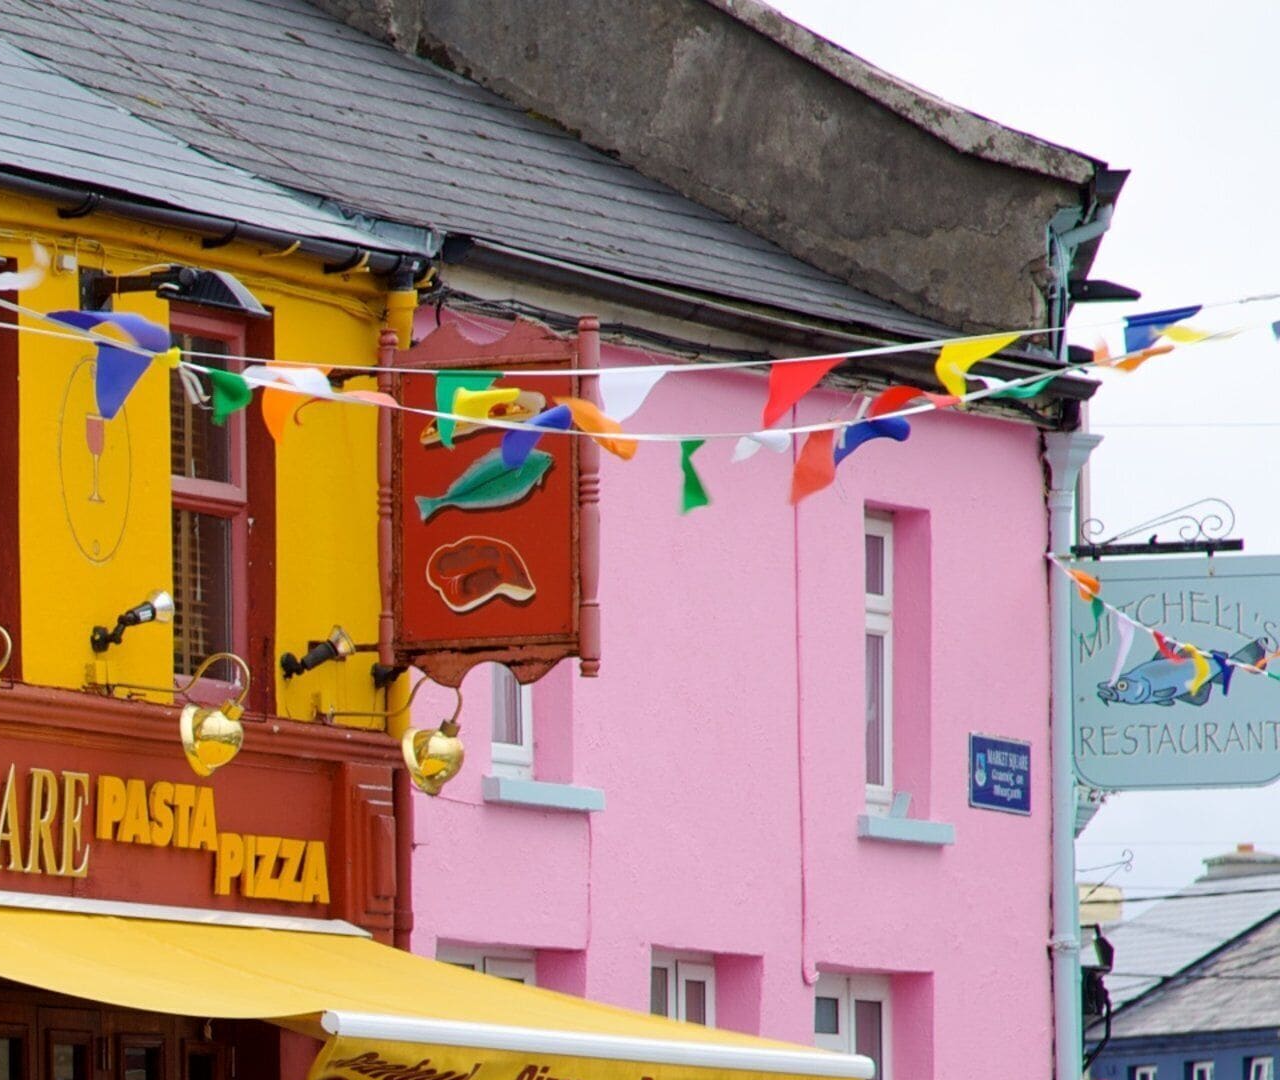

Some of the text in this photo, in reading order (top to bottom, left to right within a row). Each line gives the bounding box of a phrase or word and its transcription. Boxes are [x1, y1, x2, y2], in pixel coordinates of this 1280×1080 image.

[1079, 720, 1280, 757] RESTAURANT
[96, 774, 218, 851] PASTA
[214, 832, 331, 905] PIZZA
